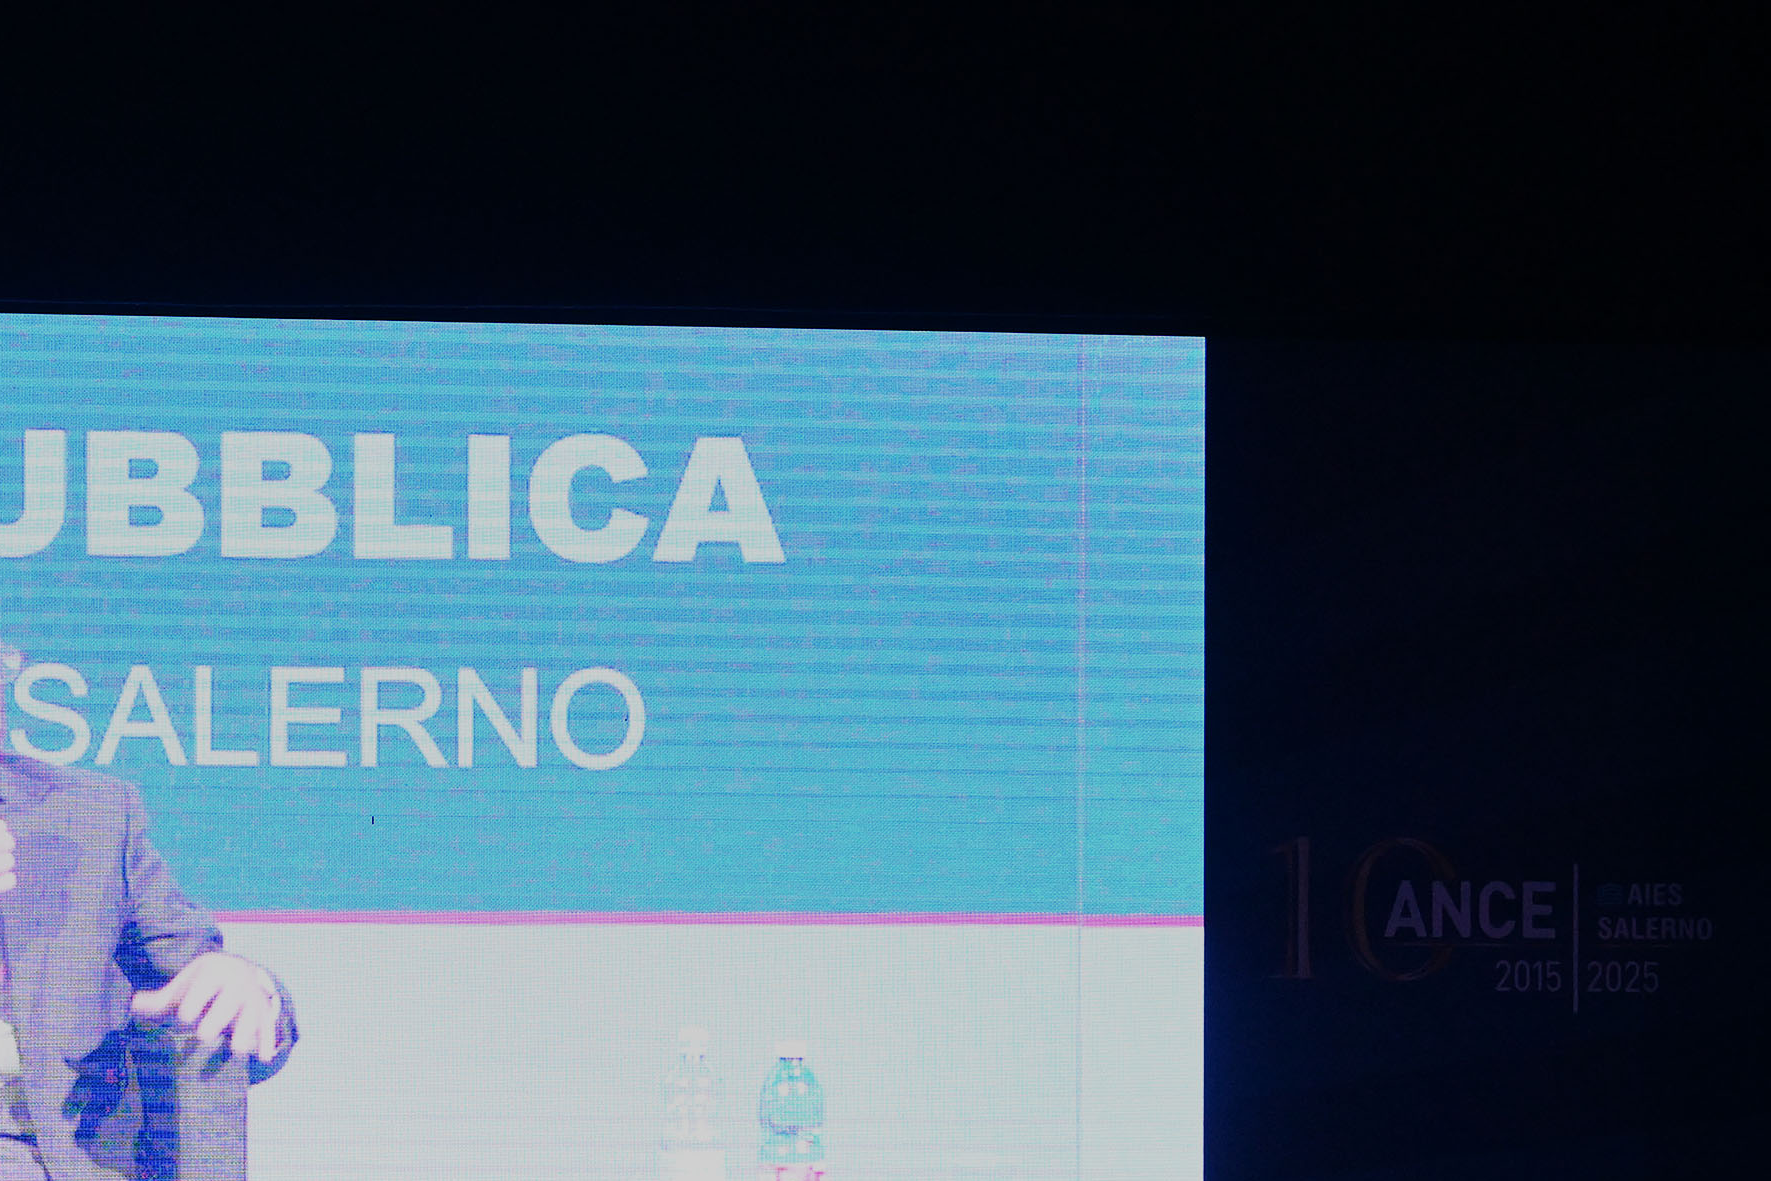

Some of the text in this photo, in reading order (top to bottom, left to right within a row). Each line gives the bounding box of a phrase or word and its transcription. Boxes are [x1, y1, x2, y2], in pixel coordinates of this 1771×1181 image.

[10, 662, 647, 770] SALERNO
[1383, 880, 1557, 939] ANCE
[1627, 882, 1684, 906] AIES
[1597, 915, 1714, 941] SALERNO
[1494, 960, 1660, 993] 2015 2025
